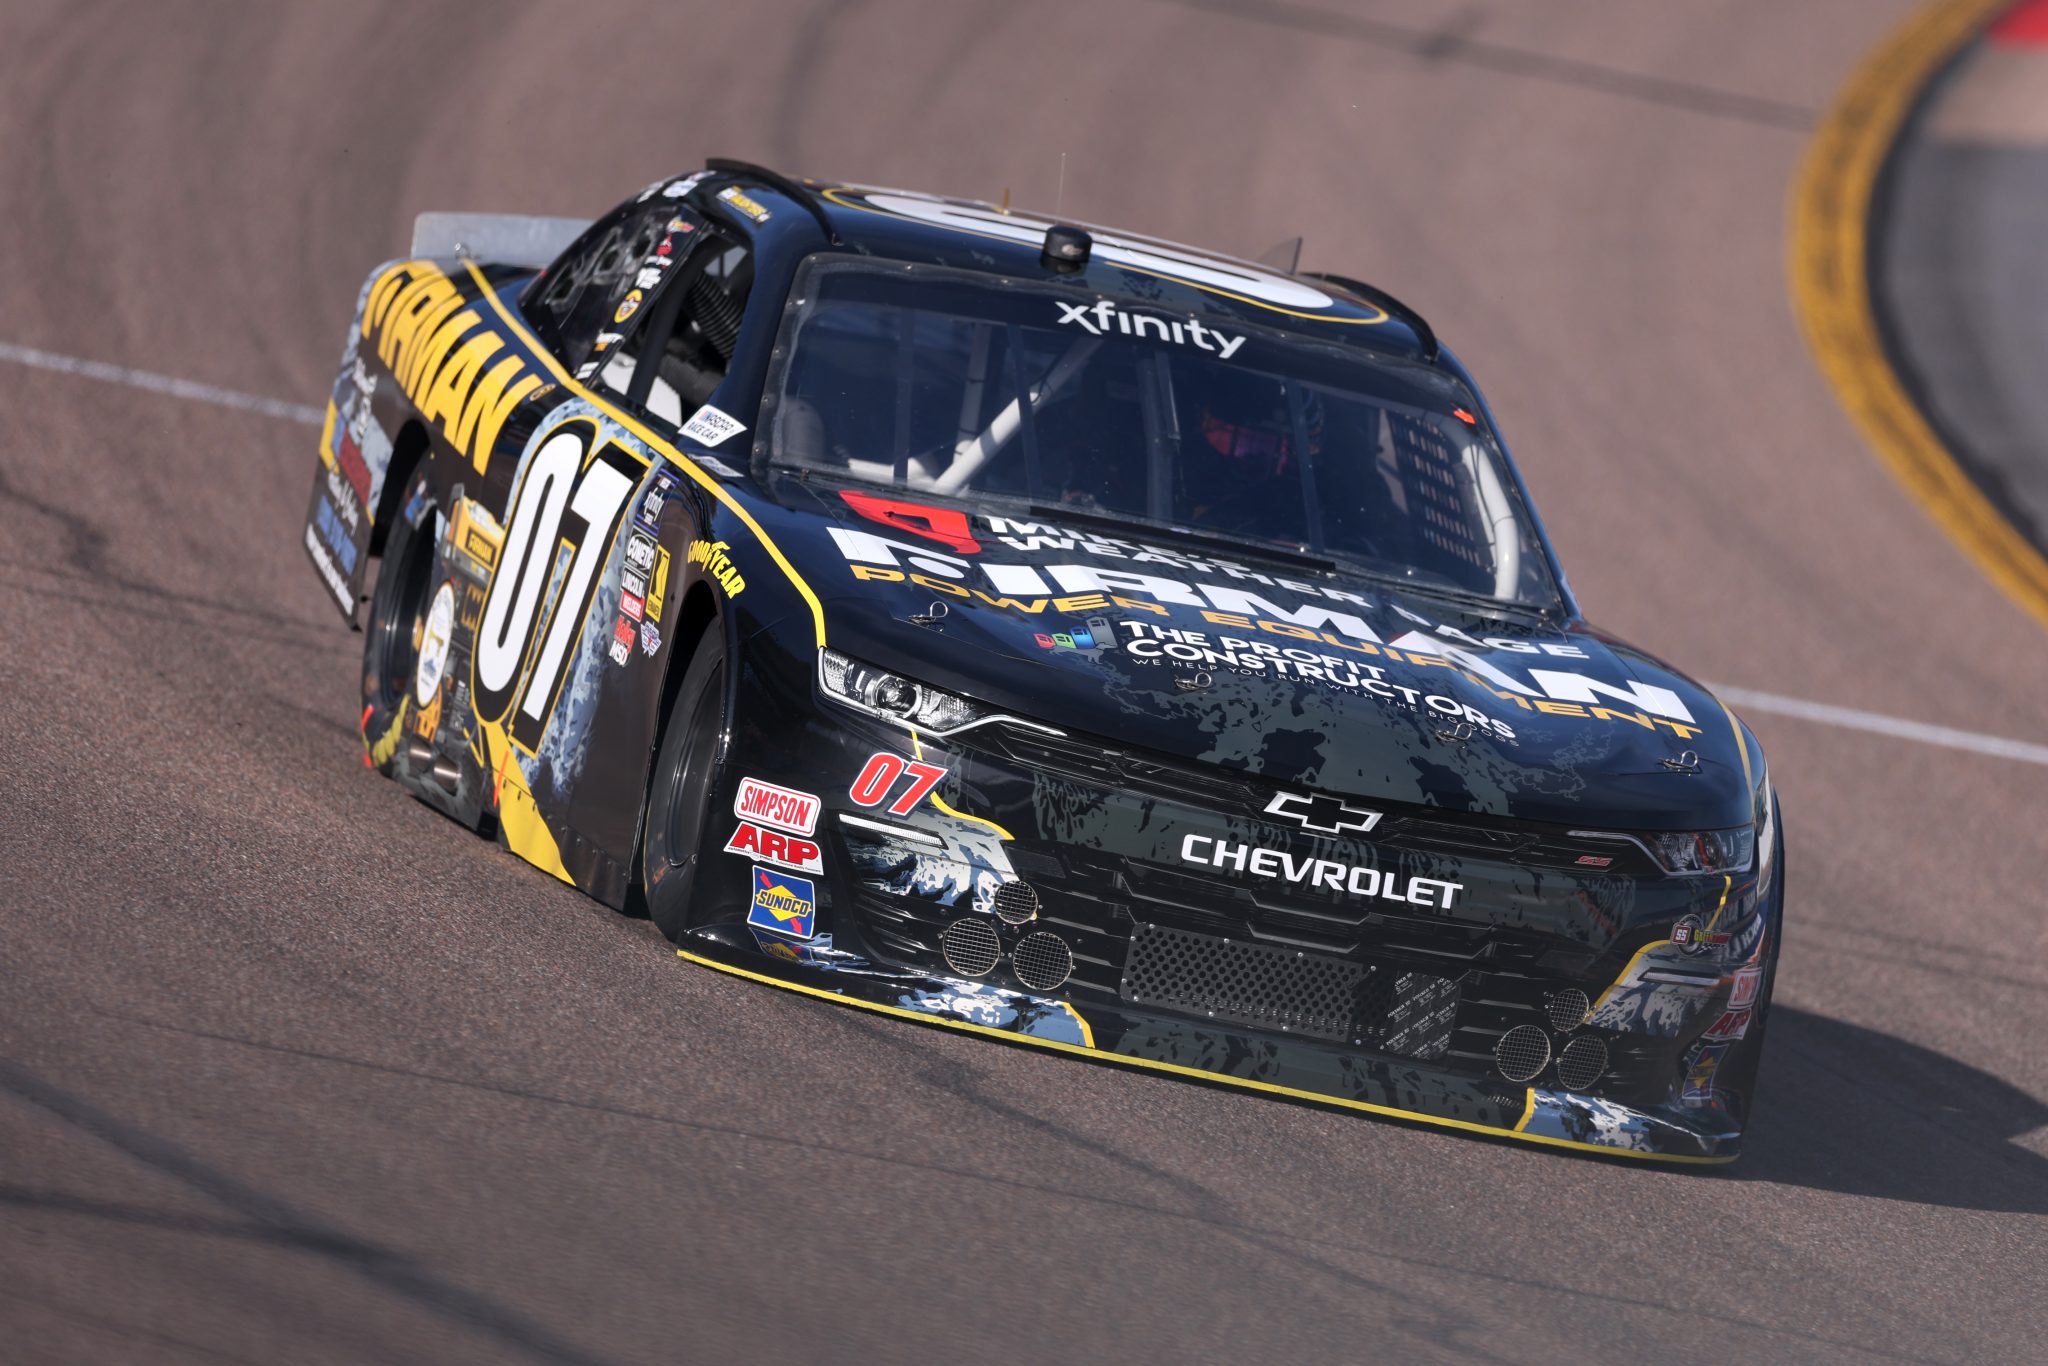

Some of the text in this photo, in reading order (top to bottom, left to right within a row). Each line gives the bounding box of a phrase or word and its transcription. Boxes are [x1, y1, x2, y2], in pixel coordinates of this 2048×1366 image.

[1055, 301, 1246, 359] xfinity
[701, 428, 719, 440] CAR
[705, 411, 734, 433] NASCAR
[478, 432, 634, 722] 07
[687, 540, 746, 600] GOODYEAR
[997, 536, 1374, 608] WEATHER
[609, 639, 630, 667] MSD
[826, 527, 1697, 724] FIRMAN
[850, 564, 1703, 740] POWER EQUIPMENT
[1120, 621, 1386, 680] THE PROFIT
[1126, 639, 1516, 739] CONSTRUCTORS
[1132, 658, 1162, 666] WE
[1172, 660, 1218, 671] HELP
[1229, 667, 1266, 678] YOU
[1277, 673, 1315, 685] RUN
[1325, 683, 1374, 700] WITH
[1385, 698, 1418, 713] THE
[1428, 710, 1458, 725] BIG
[740, 785, 811, 827] SIMPSON
[849, 752, 949, 816] 07
[729, 823, 819, 865] ARP
[1180, 834, 1464, 910] CHEVROLET
[757, 890, 810, 916] SUNOCO
